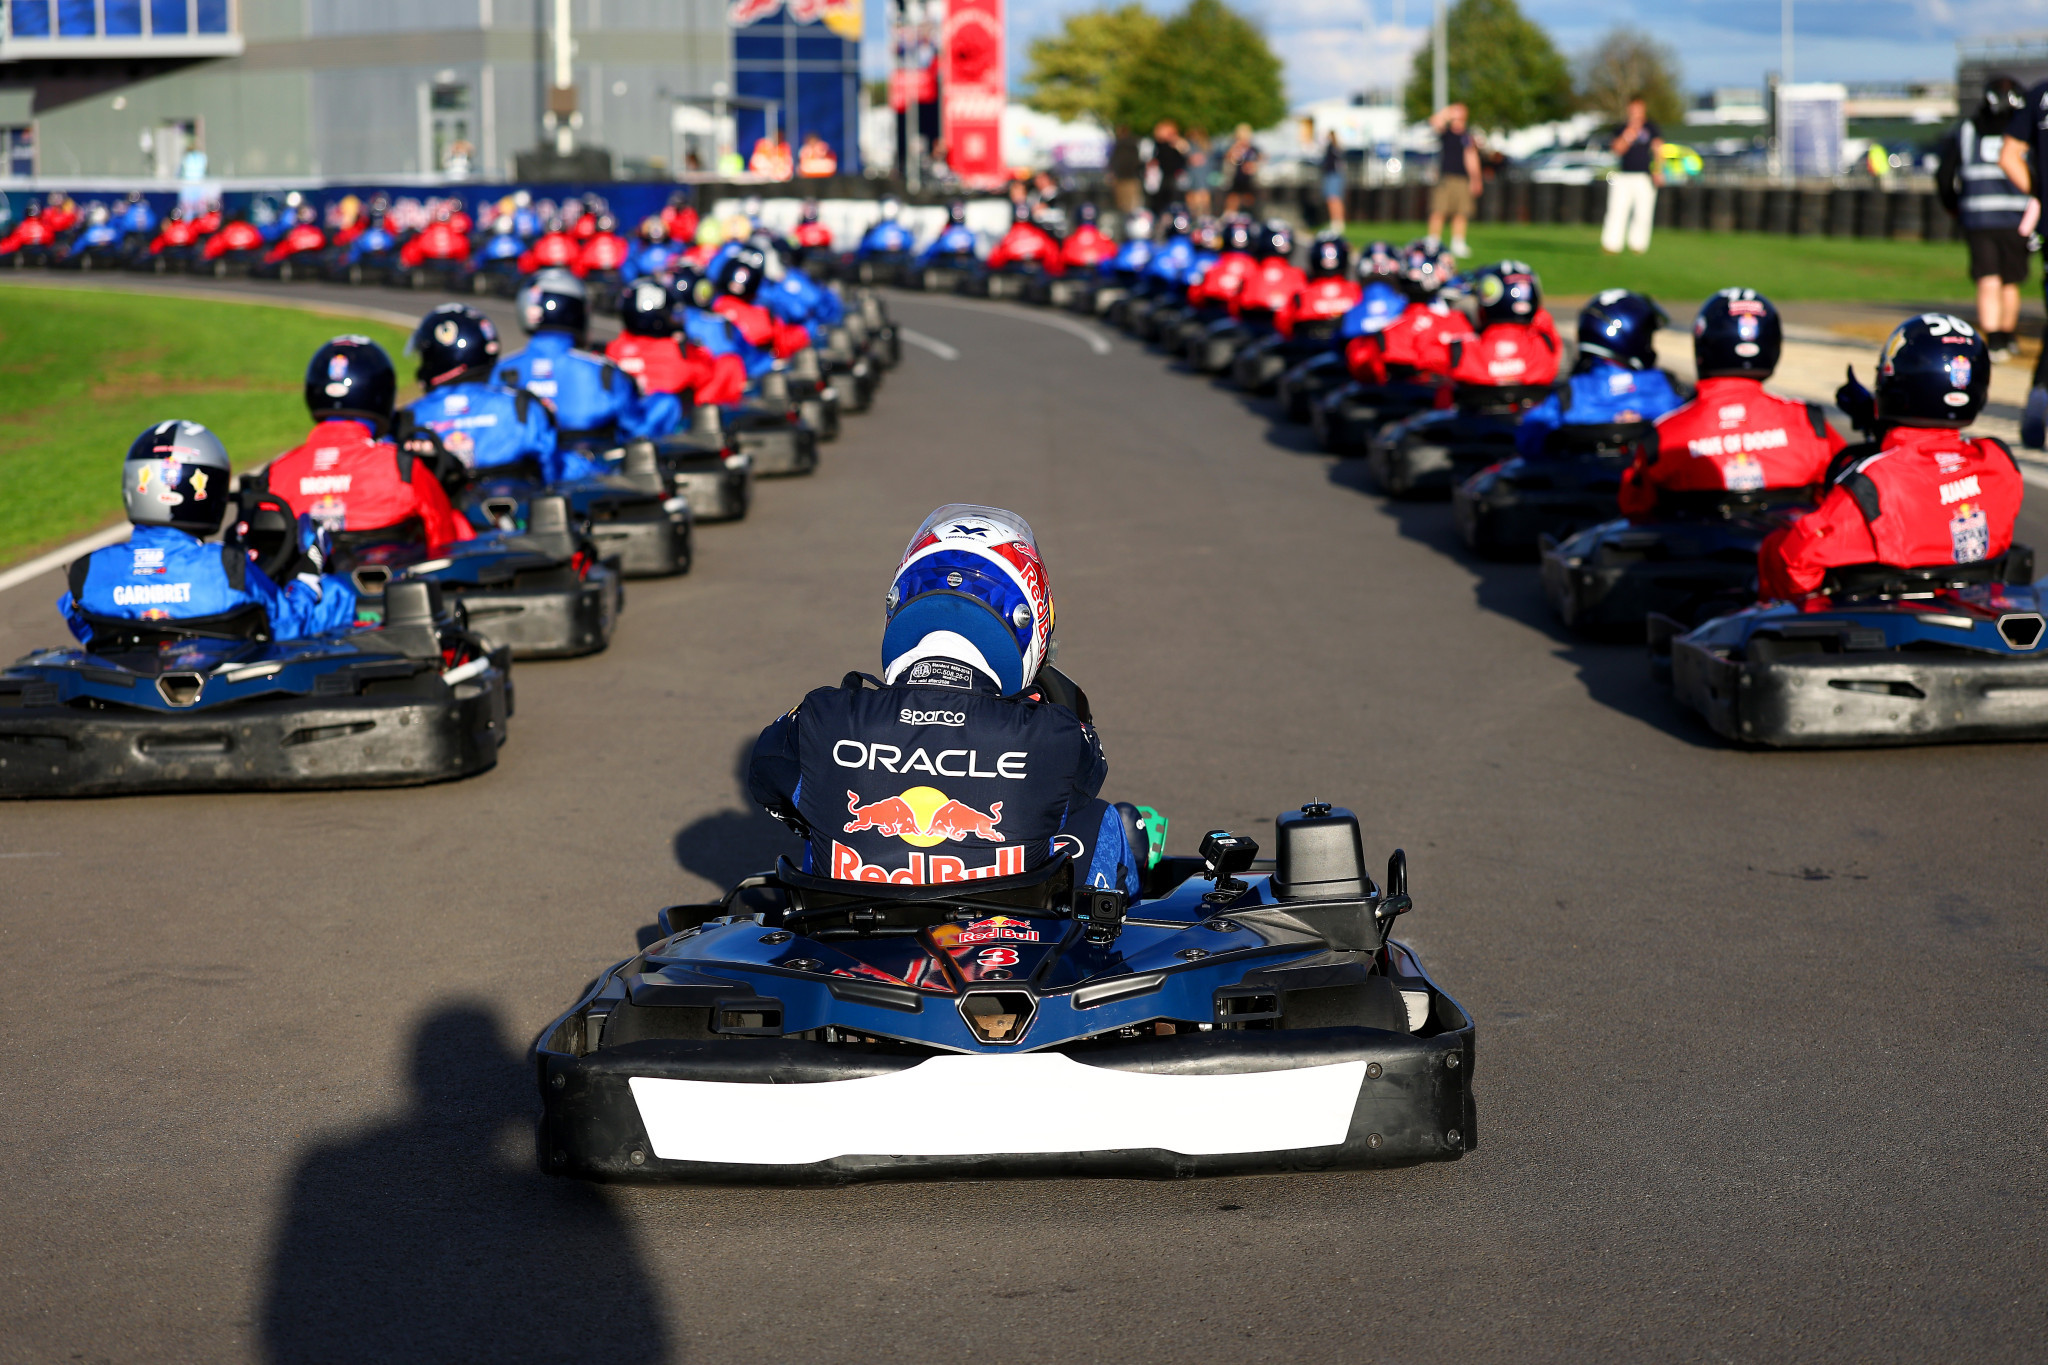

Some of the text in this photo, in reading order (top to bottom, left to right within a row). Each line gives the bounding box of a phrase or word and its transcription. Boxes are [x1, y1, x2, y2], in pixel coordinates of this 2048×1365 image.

[1921, 312, 1974, 337] 56
[113, 583, 191, 606] GARNBRET
[1020, 561, 1048, 622] Red
[900, 708, 966, 726] sparco
[832, 739, 1029, 780] ORACLE
[831, 839, 926, 885] Red
[959, 927, 1040, 943] Red Bull
[976, 947, 1020, 966] 3
